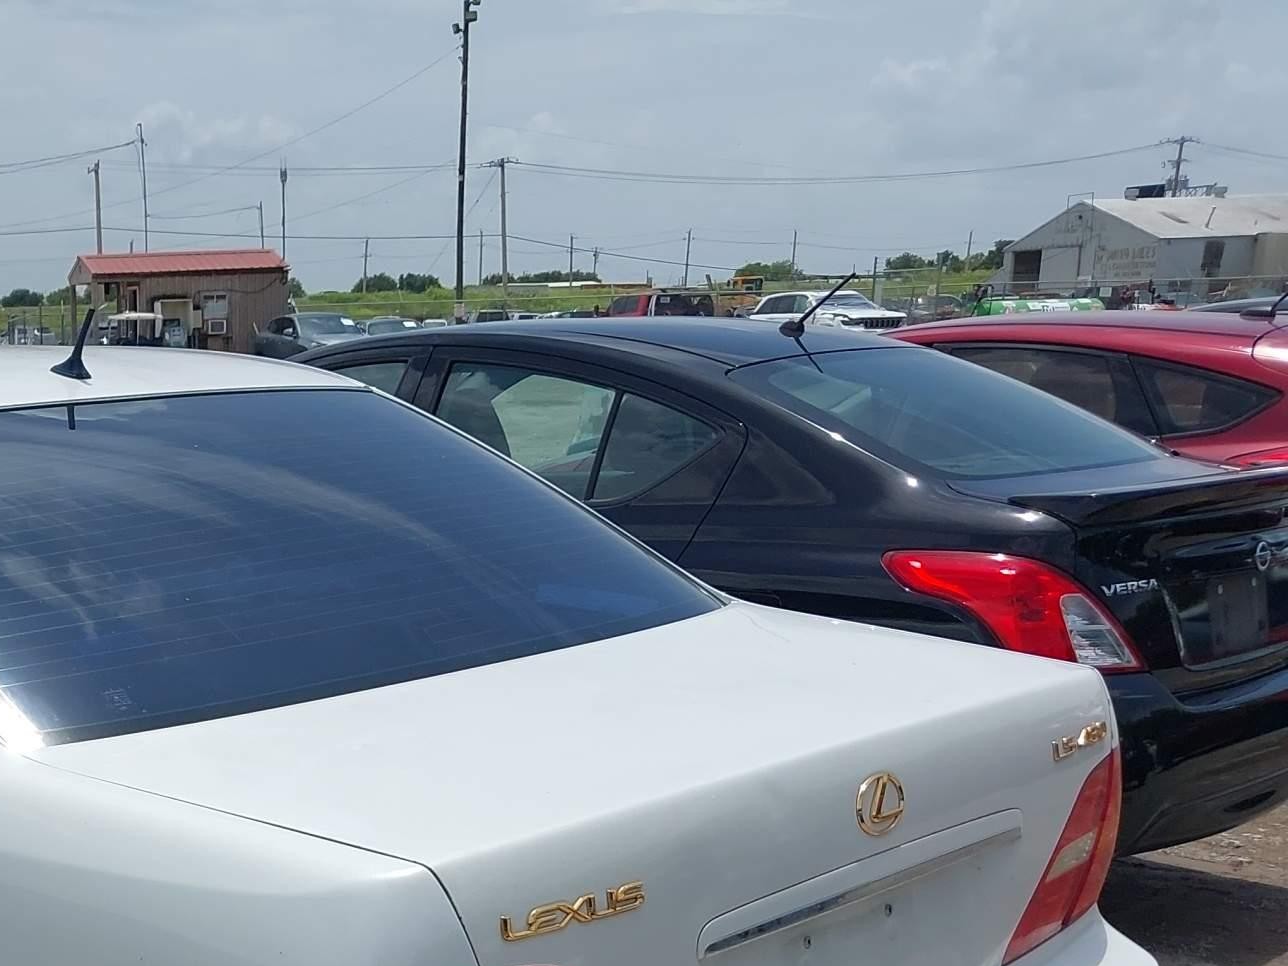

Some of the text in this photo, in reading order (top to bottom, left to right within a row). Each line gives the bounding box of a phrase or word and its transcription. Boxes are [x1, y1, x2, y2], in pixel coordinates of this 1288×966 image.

[1100, 578, 1159, 597] VERSA
[1051, 736, 1078, 761] LS
[499, 880, 645, 942] LEXUS
